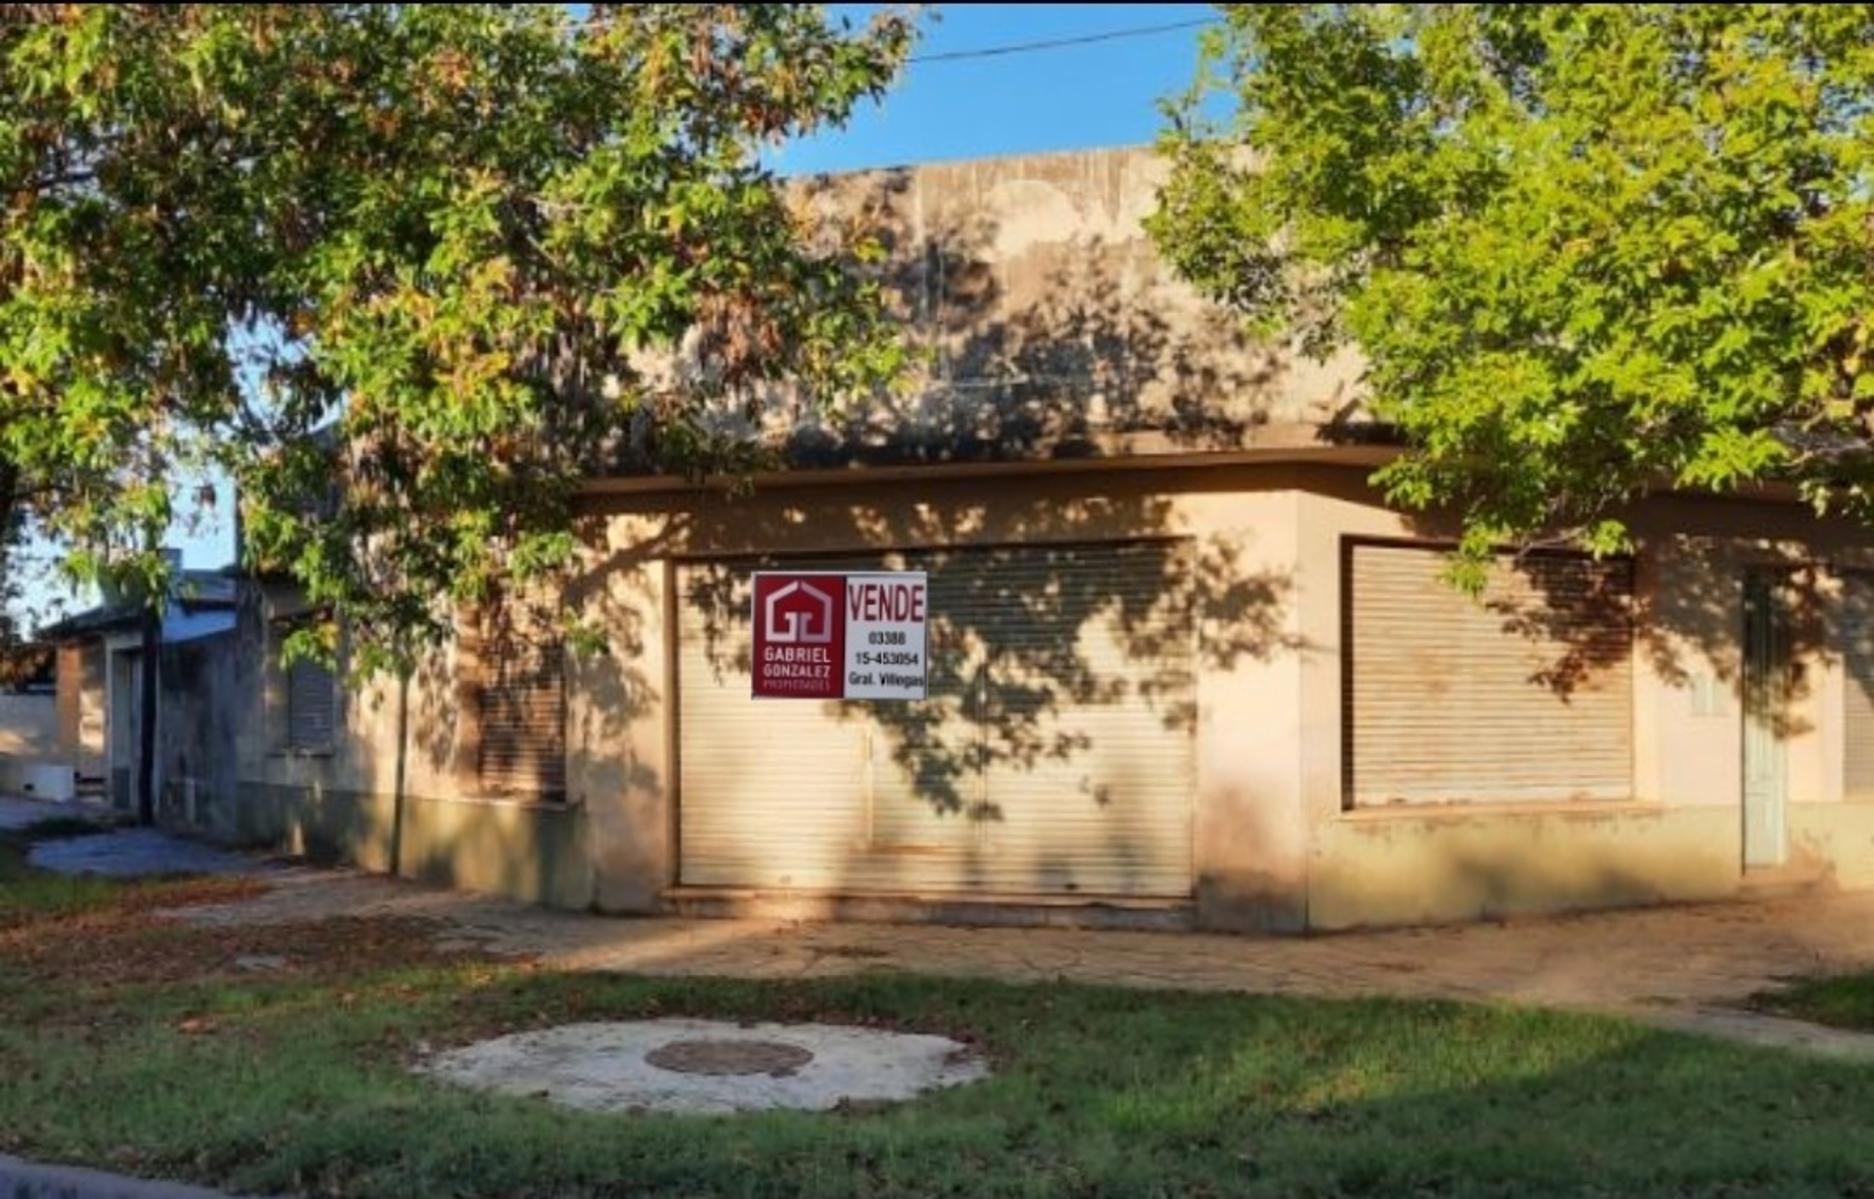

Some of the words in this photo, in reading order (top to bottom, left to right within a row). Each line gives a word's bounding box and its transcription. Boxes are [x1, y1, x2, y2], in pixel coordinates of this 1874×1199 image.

[849, 584, 924, 622] VENDE
[868, 631, 906, 645] 03388
[764, 647, 831, 663] GABRIEL
[856, 652, 918, 665] 15-453054
[763, 664, 831, 678] GONZALEZ
[849, 672, 875, 685] Gral.
[879, 672, 924, 688] Villegas
